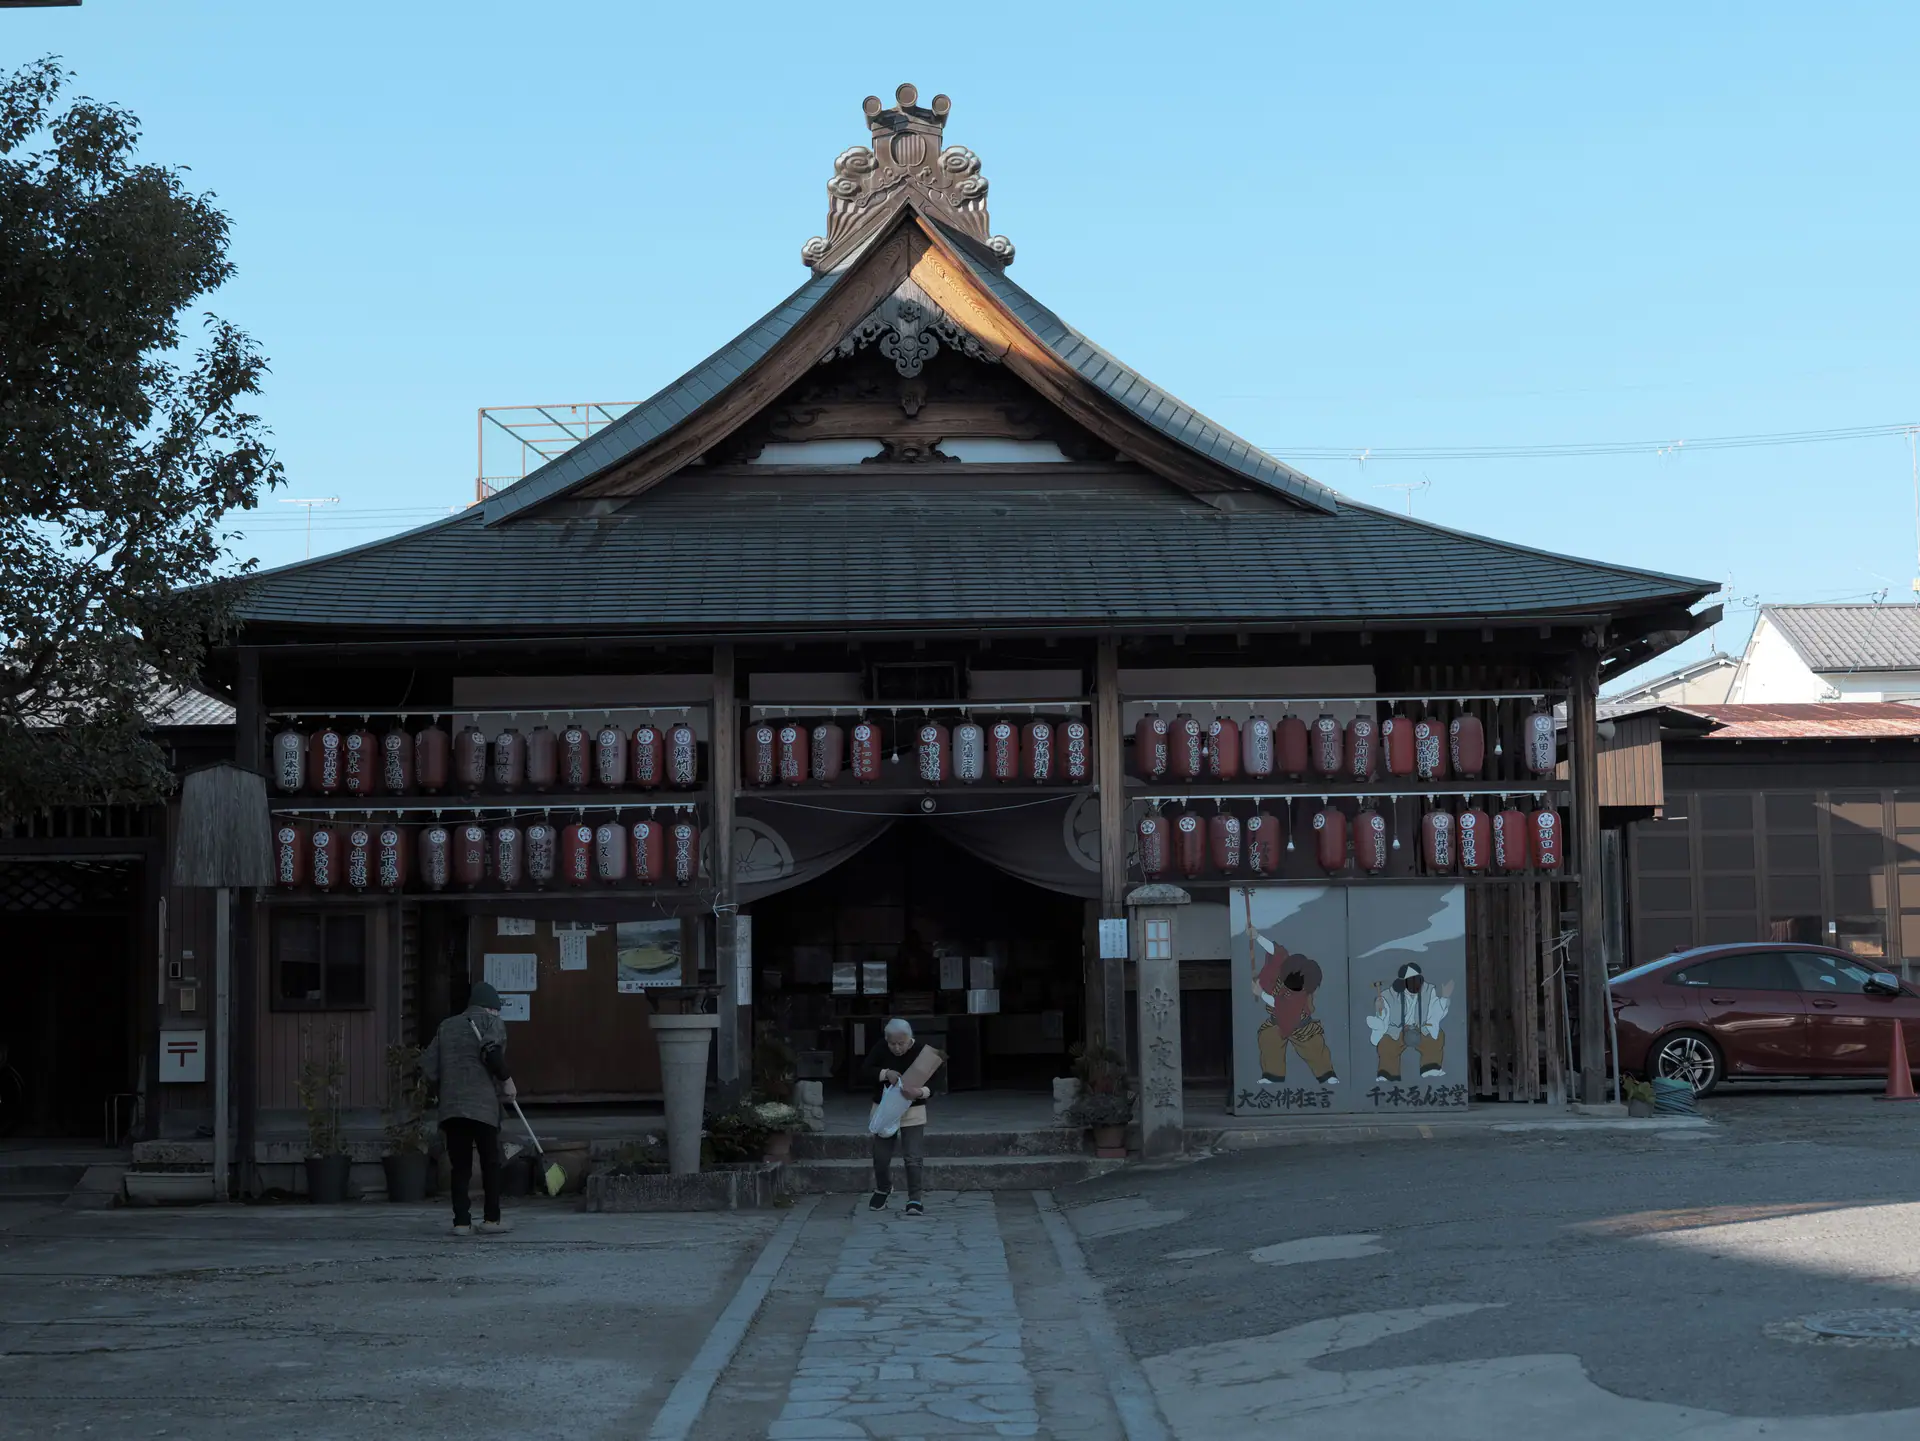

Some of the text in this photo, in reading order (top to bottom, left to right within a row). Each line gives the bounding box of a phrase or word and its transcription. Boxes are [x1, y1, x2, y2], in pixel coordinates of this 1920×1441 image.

[1537, 733, 1549, 769] 成田くに
[1237, 1088, 1334, 1110] 大念佛狂言
[1366, 1084, 1469, 1107] 千本ゑんま堂
